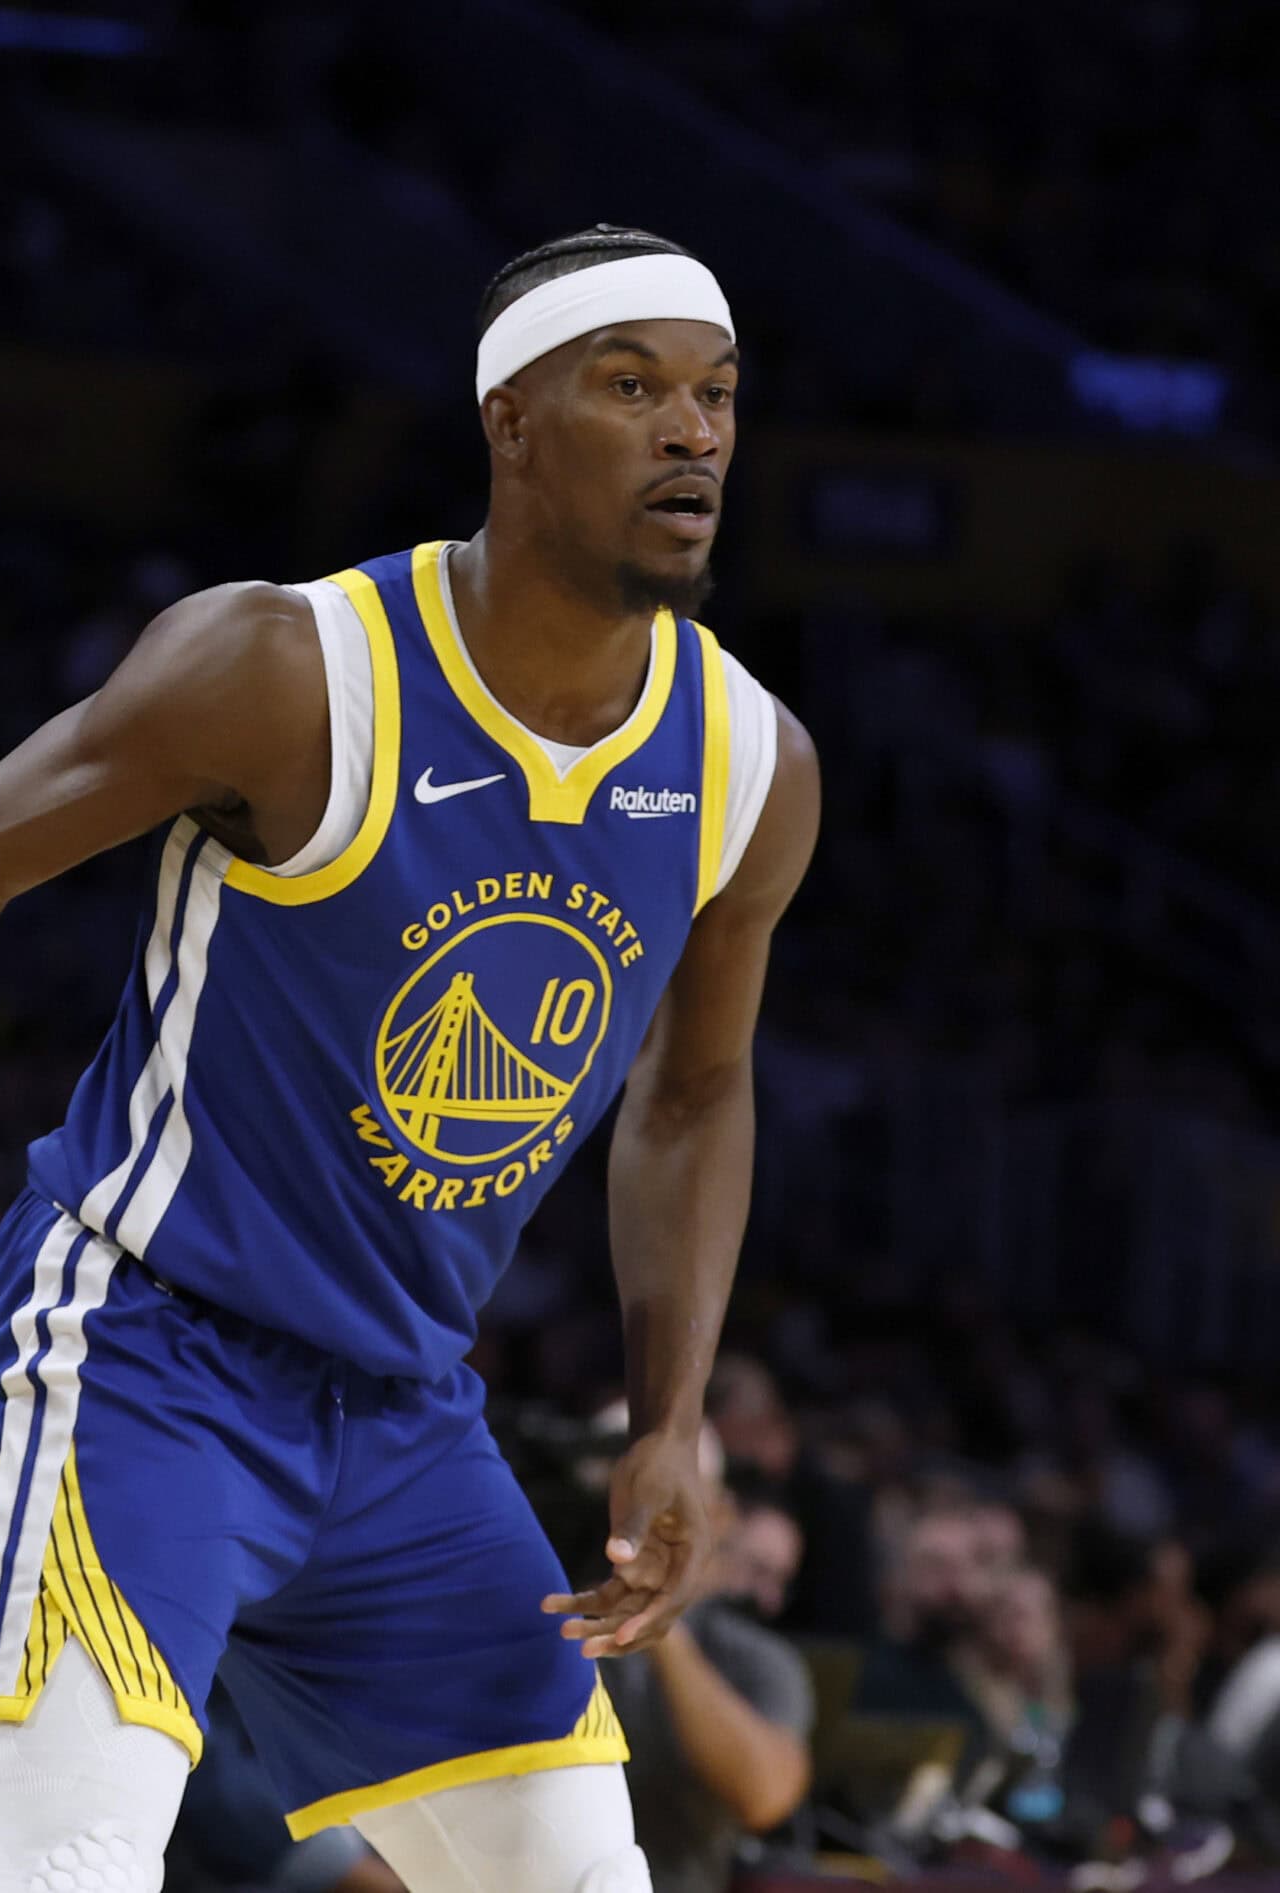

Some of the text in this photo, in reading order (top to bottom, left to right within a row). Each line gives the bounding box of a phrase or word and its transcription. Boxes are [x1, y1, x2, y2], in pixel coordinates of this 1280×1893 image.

[609, 786, 696, 815] Rakuten
[401, 871, 644, 967] GOLDEN STATE
[530, 977, 596, 1046] 10
[349, 1103, 575, 1211] WARRIORS
